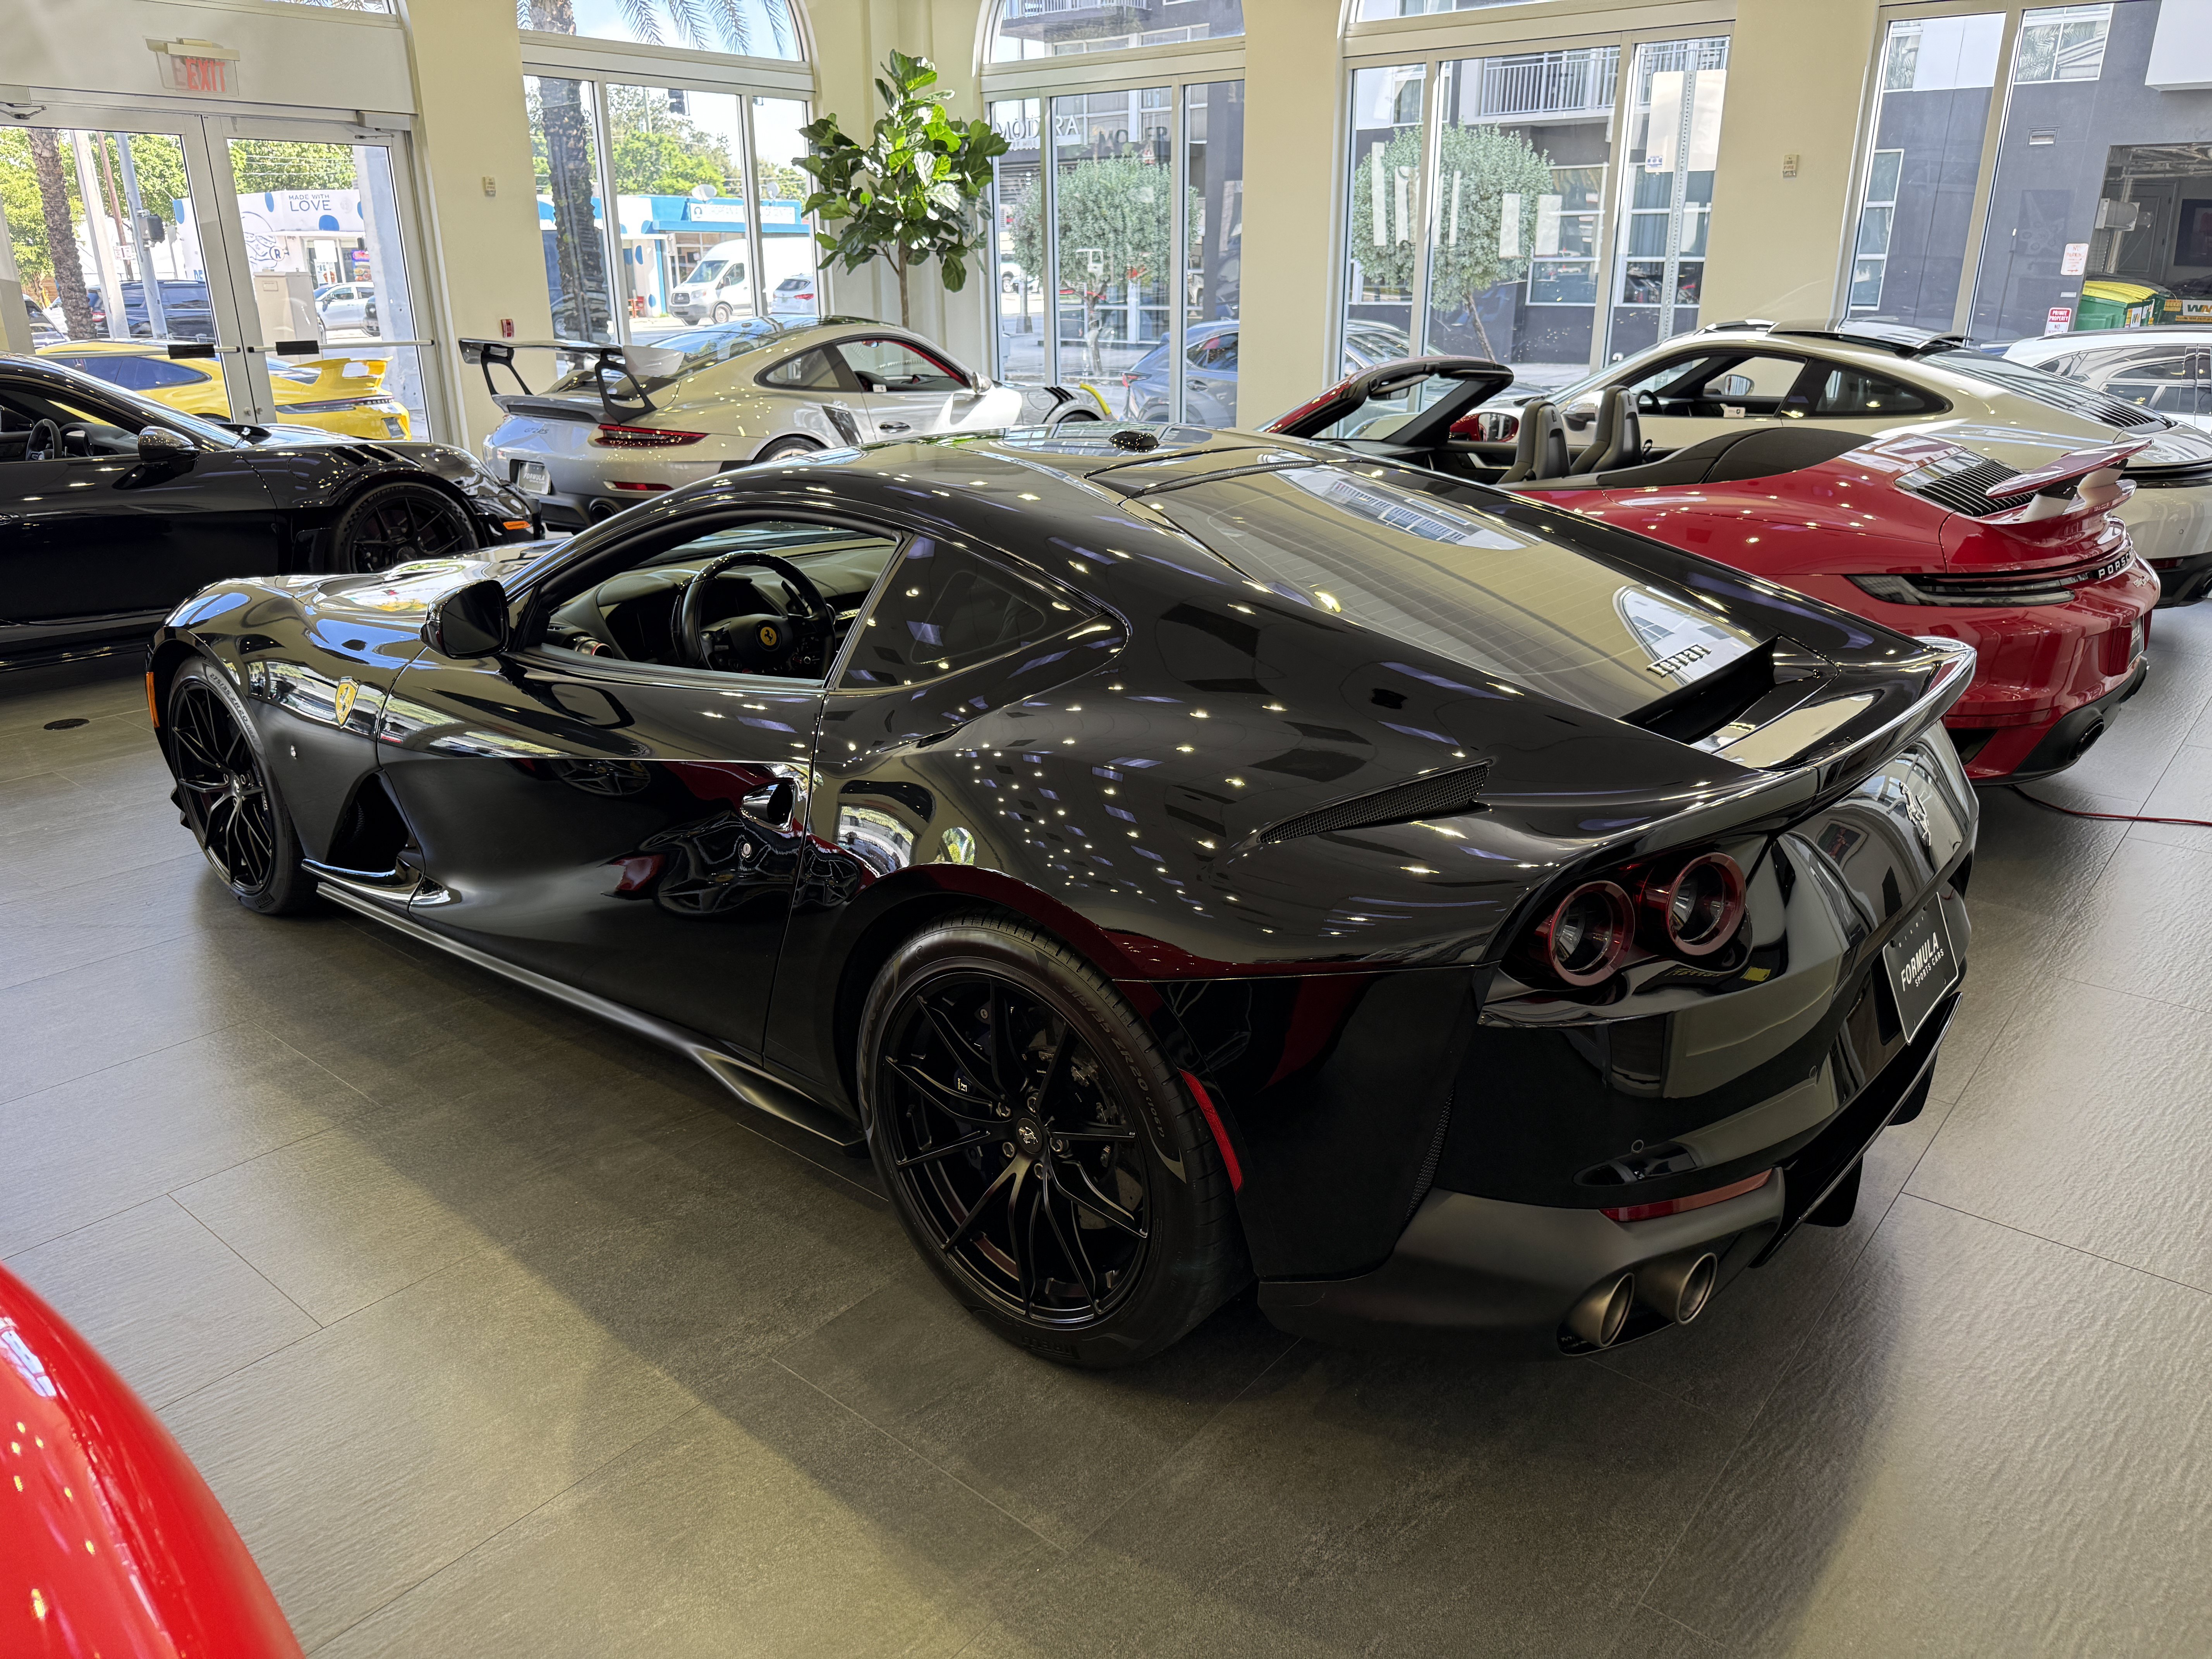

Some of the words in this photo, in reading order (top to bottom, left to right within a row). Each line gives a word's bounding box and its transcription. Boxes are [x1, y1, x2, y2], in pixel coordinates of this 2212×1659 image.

[185, 58, 225, 92] EXIT
[996, 115, 1079, 143] MODRA
[290, 200, 331, 211] LOVE
[523, 473, 545, 481] FORMULA
[1646, 642, 1712, 678] Ferrari
[1901, 932, 1939, 992] FORMULA
[1915, 963, 1931, 987] SPORTS
[1932, 948, 1944, 966] CARS
